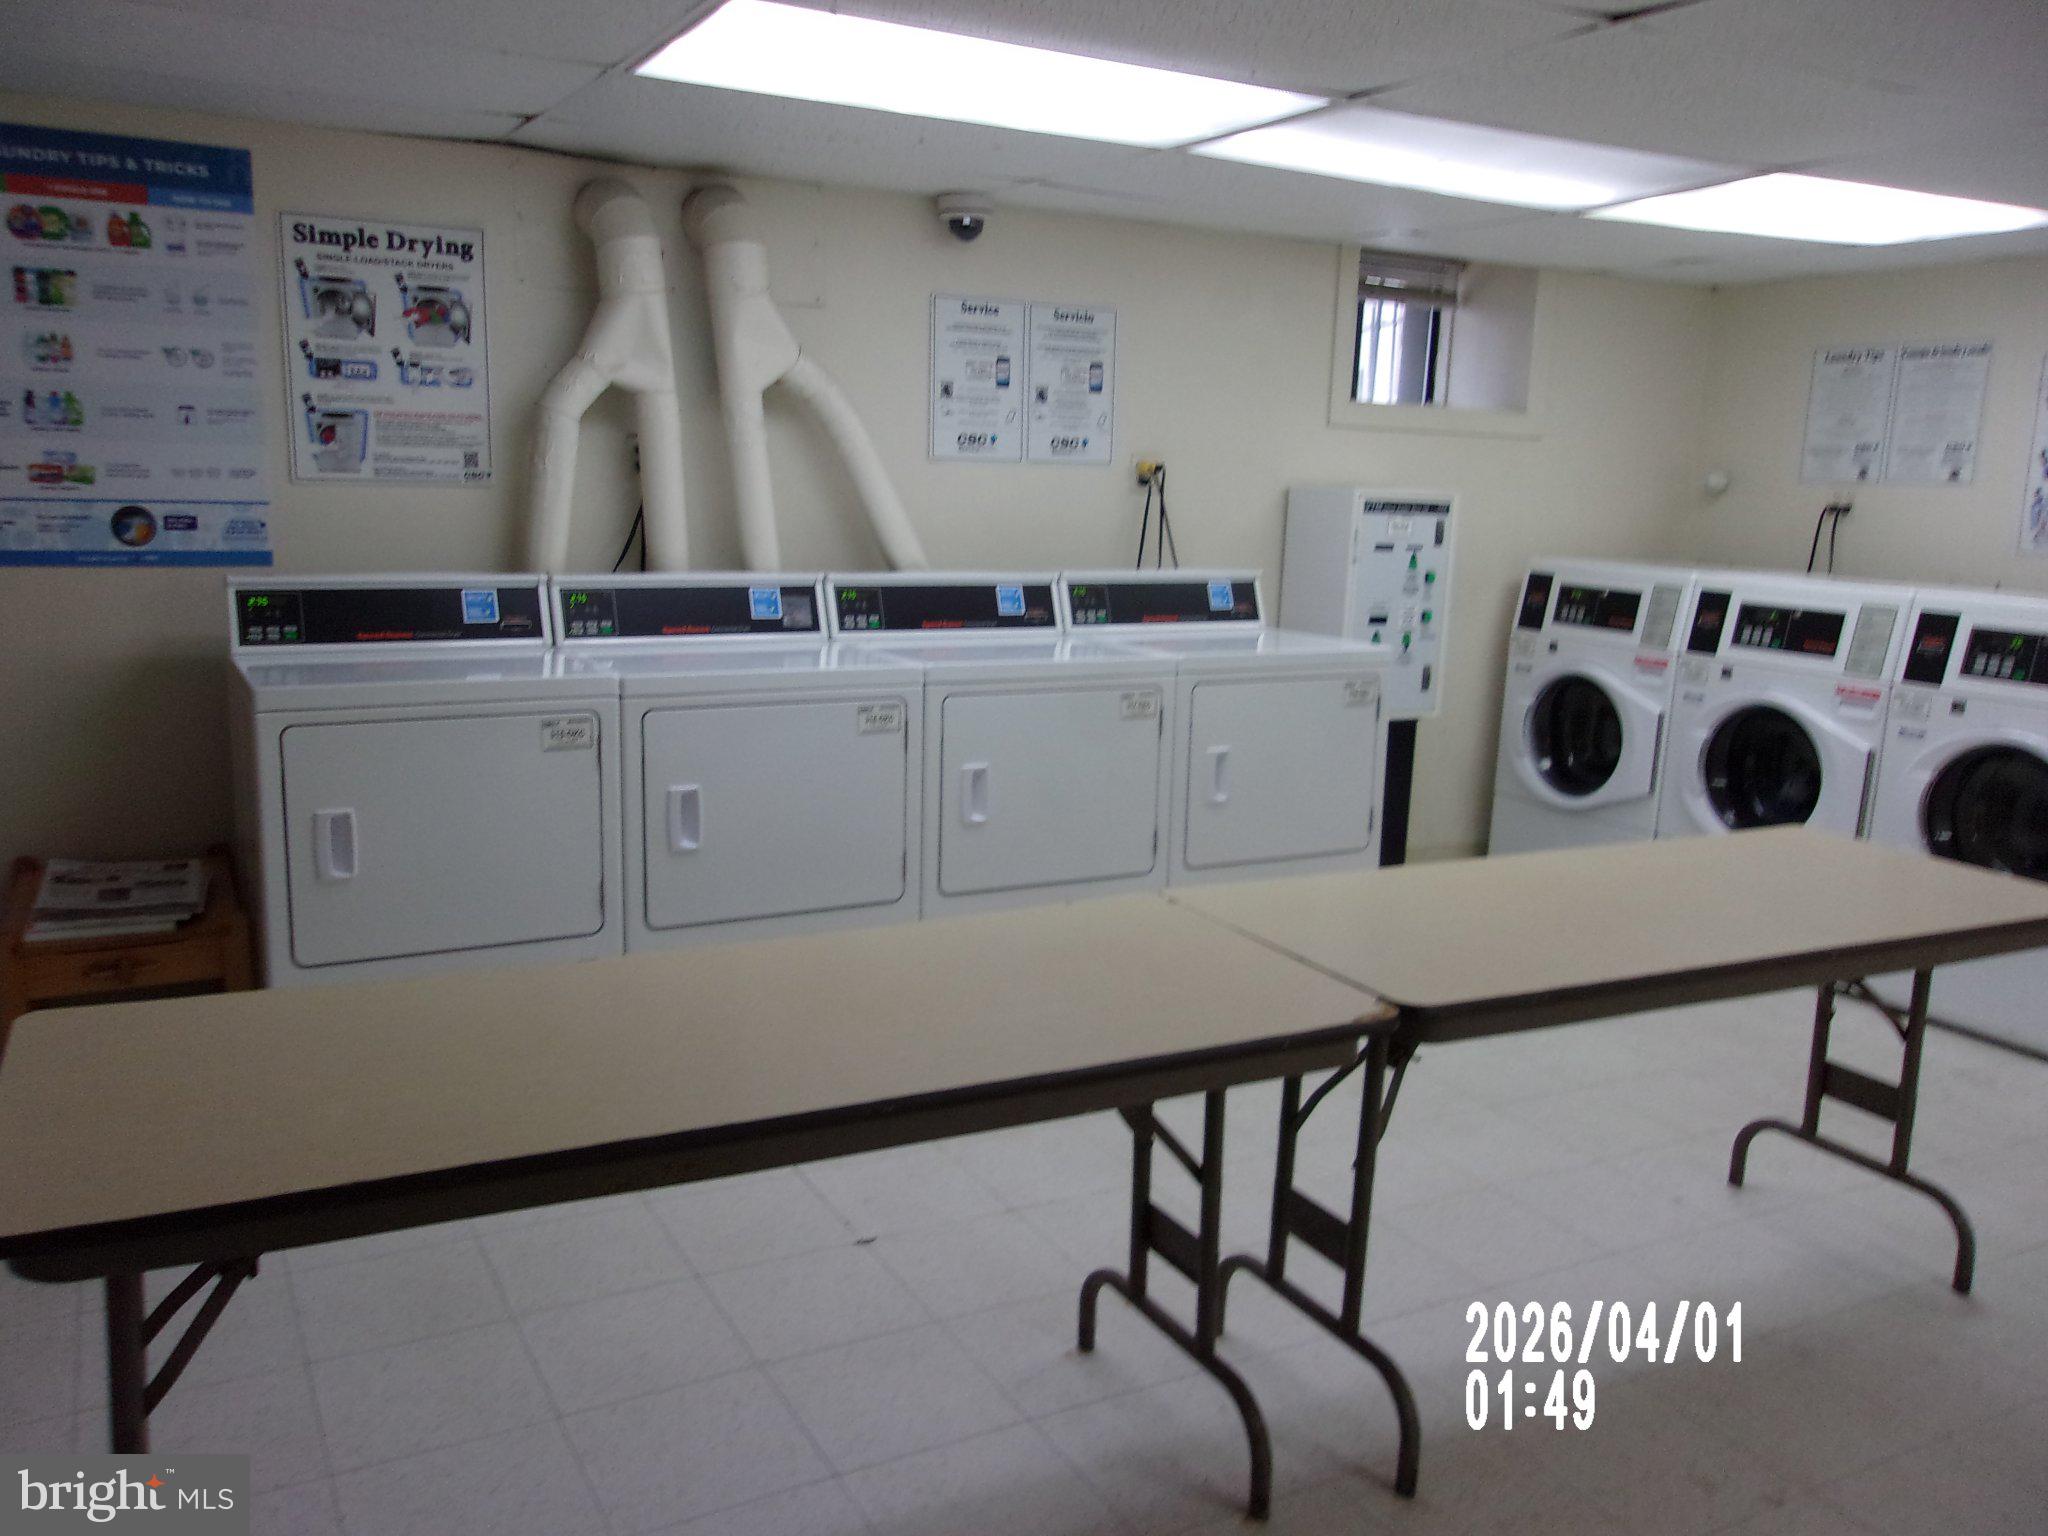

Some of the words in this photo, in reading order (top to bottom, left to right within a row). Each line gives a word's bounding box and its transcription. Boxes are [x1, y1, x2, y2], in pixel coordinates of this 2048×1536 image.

[0, 144, 70, 164] UNDRY
[76, 150, 120, 169] TIPS
[143, 159, 209, 178] TRICKS
[292, 223, 379, 252] Simple
[386, 230, 475, 262] Drying
[961, 299, 1000, 317] Service
